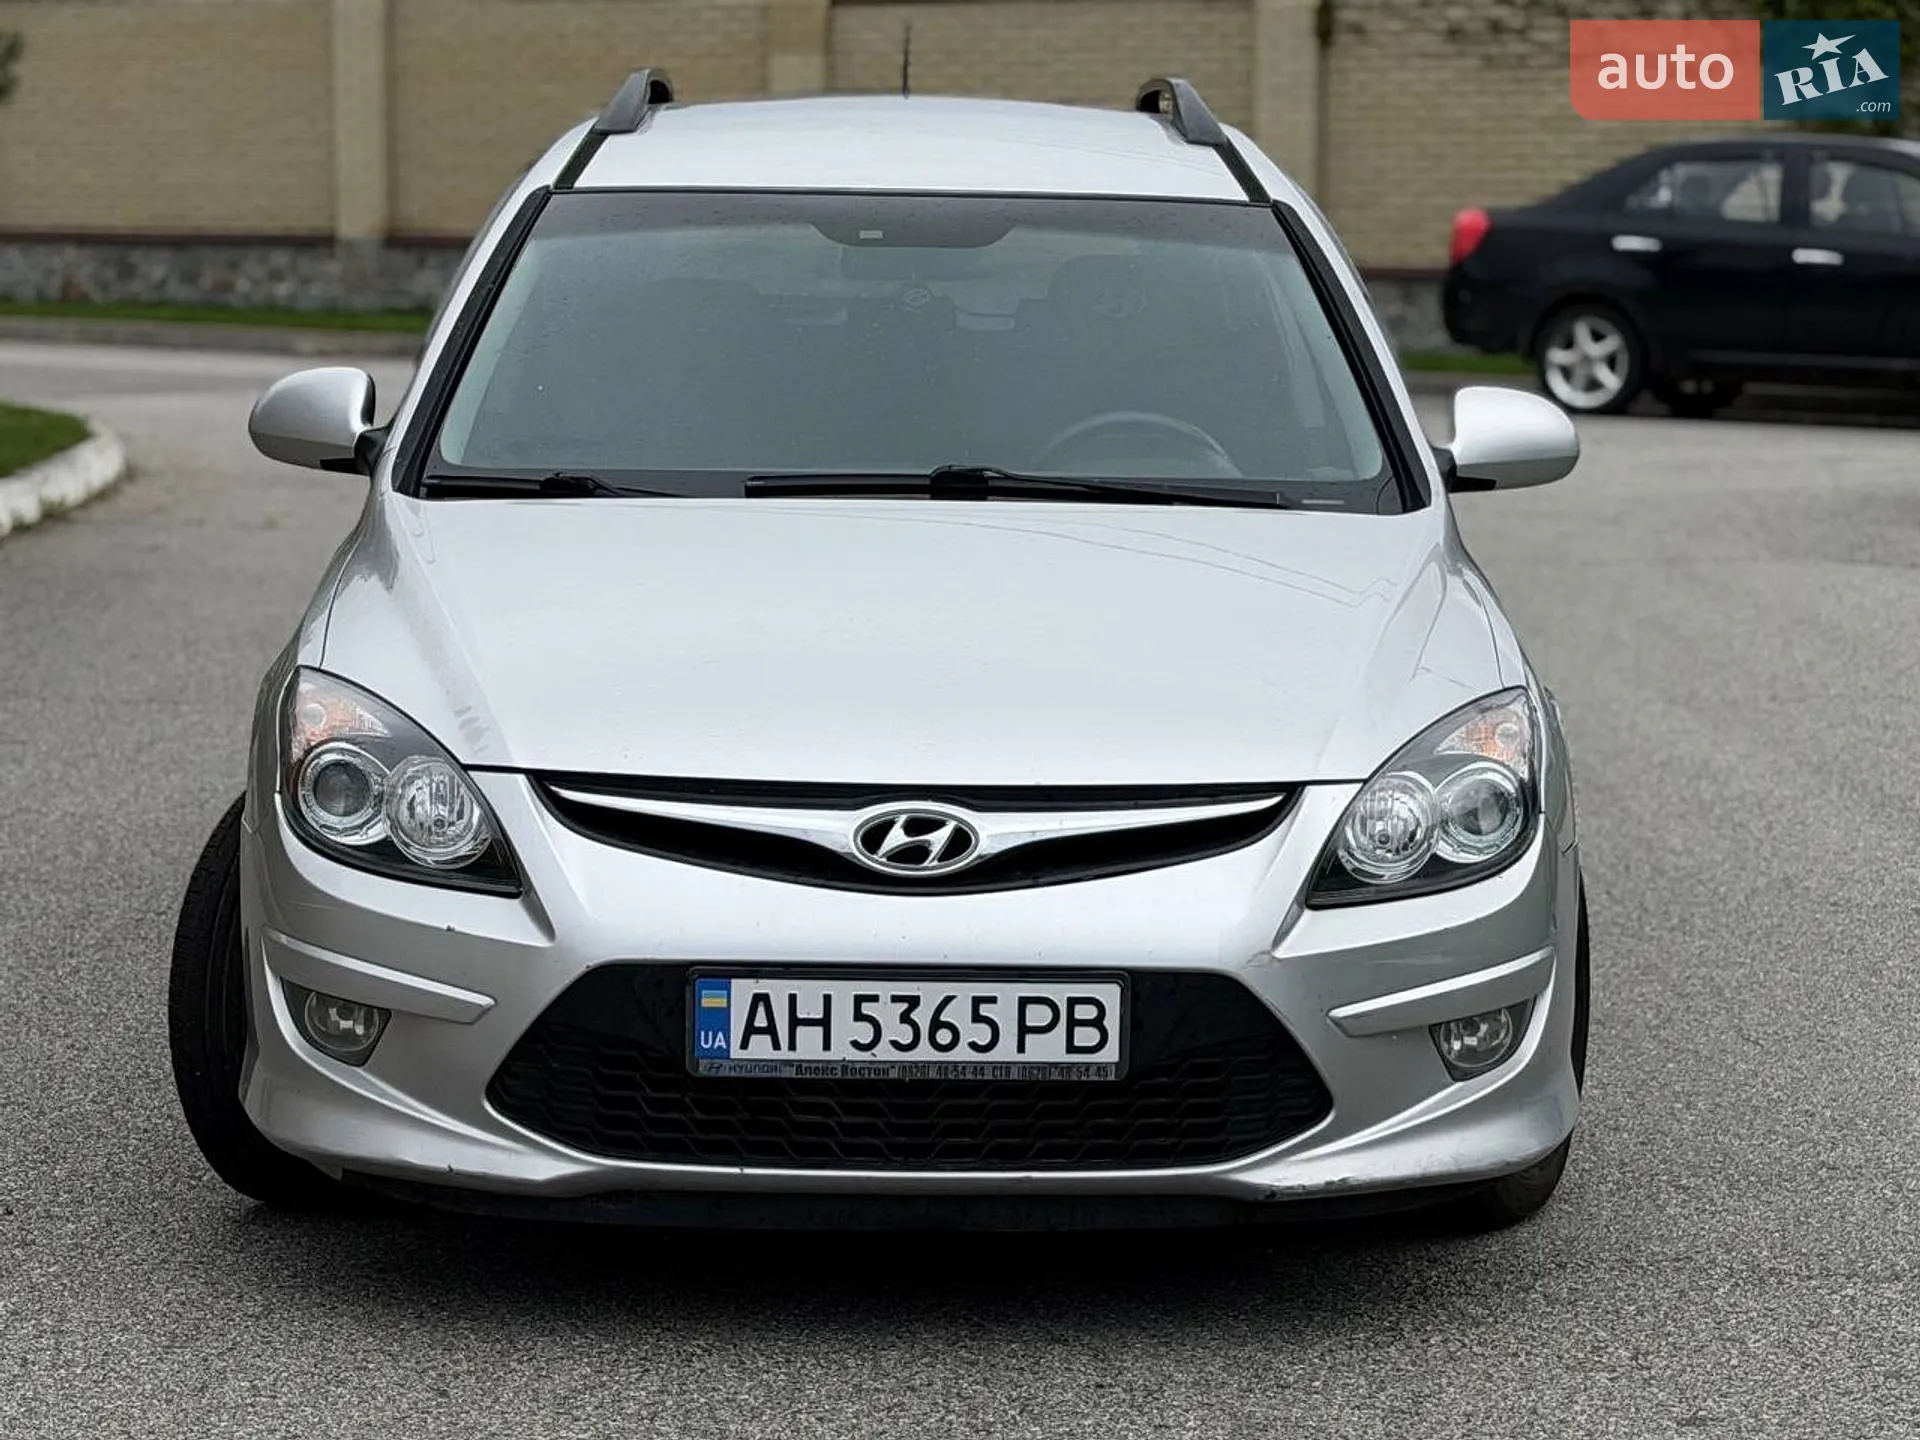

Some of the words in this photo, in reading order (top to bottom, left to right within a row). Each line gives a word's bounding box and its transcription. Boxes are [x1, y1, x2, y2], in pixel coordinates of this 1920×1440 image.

[700, 1031, 727, 1049] UA
[739, 992, 832, 1052] AH
[849, 993, 1000, 1054] 5365
[1016, 995, 1109, 1055] PB
